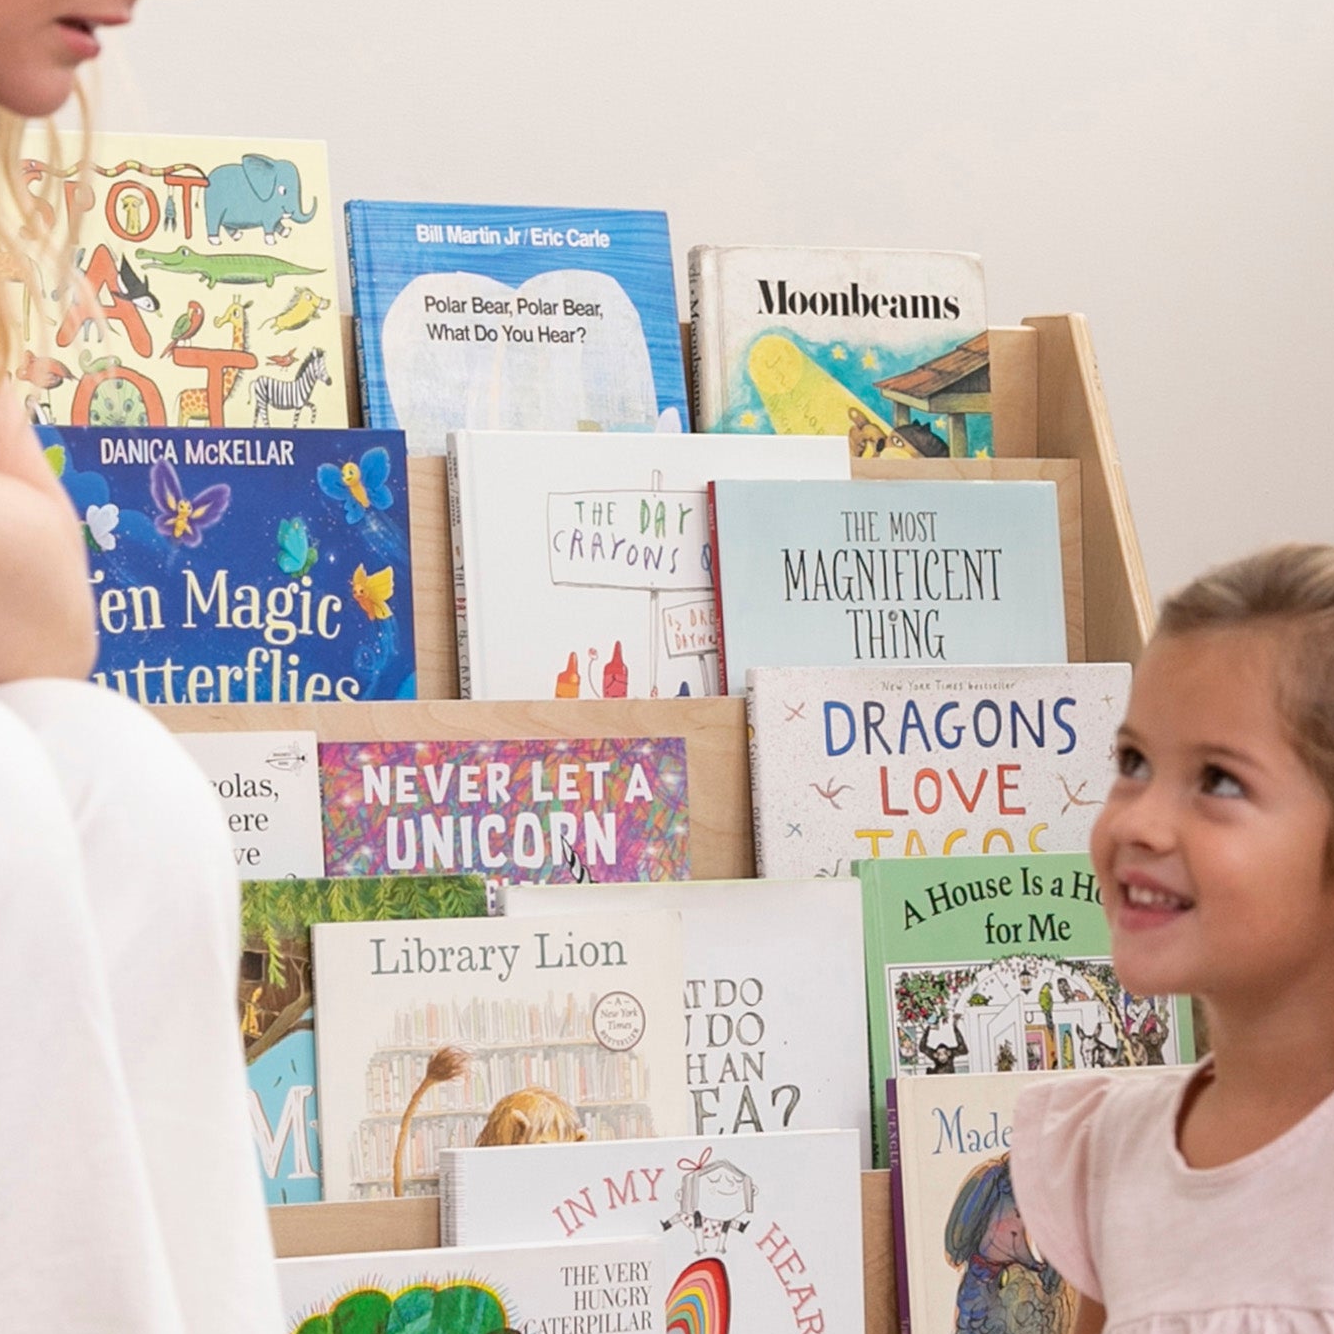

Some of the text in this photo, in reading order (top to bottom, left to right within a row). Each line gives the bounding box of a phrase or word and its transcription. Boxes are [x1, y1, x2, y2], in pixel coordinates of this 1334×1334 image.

[417, 224, 443, 244] Bill
[447, 225, 501, 246] Martin
[504, 226, 521, 246] Jr
[530, 227, 564, 248] Eric
[567, 229, 610, 249] Carle
[424, 295, 603, 319] Polar Bear, Polar Bear,
[756, 279, 960, 320] Moonbeams
[425, 323, 586, 344] What Do You Hear?
[101, 438, 295, 466] DANICA McKELLAR
[574, 501, 616, 526] THE
[639, 499, 693, 539] DAY
[840, 511, 938, 543] THE MOST
[553, 528, 679, 574] CRAYONS
[780, 548, 1003, 604] MAGNIFICENT
[182, 569, 342, 645] Magic
[93, 647, 361, 704] utterflies
[882, 680, 902, 691] New
[823, 697, 1077, 757] DRAGONS
[210, 772, 279, 803] olas,
[362, 761, 655, 806] NEVER LET A
[880, 764, 1026, 816] LOVE
[228, 813, 269, 832] ere
[385, 811, 618, 870] UNICORN
[904, 899, 926, 930] A
[925, 872, 1013, 916] House
[1020, 867, 1043, 896] Is
[1051, 877, 1064, 897] a
[985, 913, 1073, 944] for Me
[370, 931, 628, 982] Library Lion
[714, 978, 763, 1007] DO
[705, 1011, 765, 1048] DO
[718, 1051, 765, 1083] AN
[689, 1084, 801, 1136] EA?
[931, 1104, 1013, 1155] Made
[552, 1187, 598, 1236] IN
[603, 1167, 665, 1210] MY
[560, 1261, 653, 1287] THE VERY
[573, 1286, 653, 1312] HUNGRY
